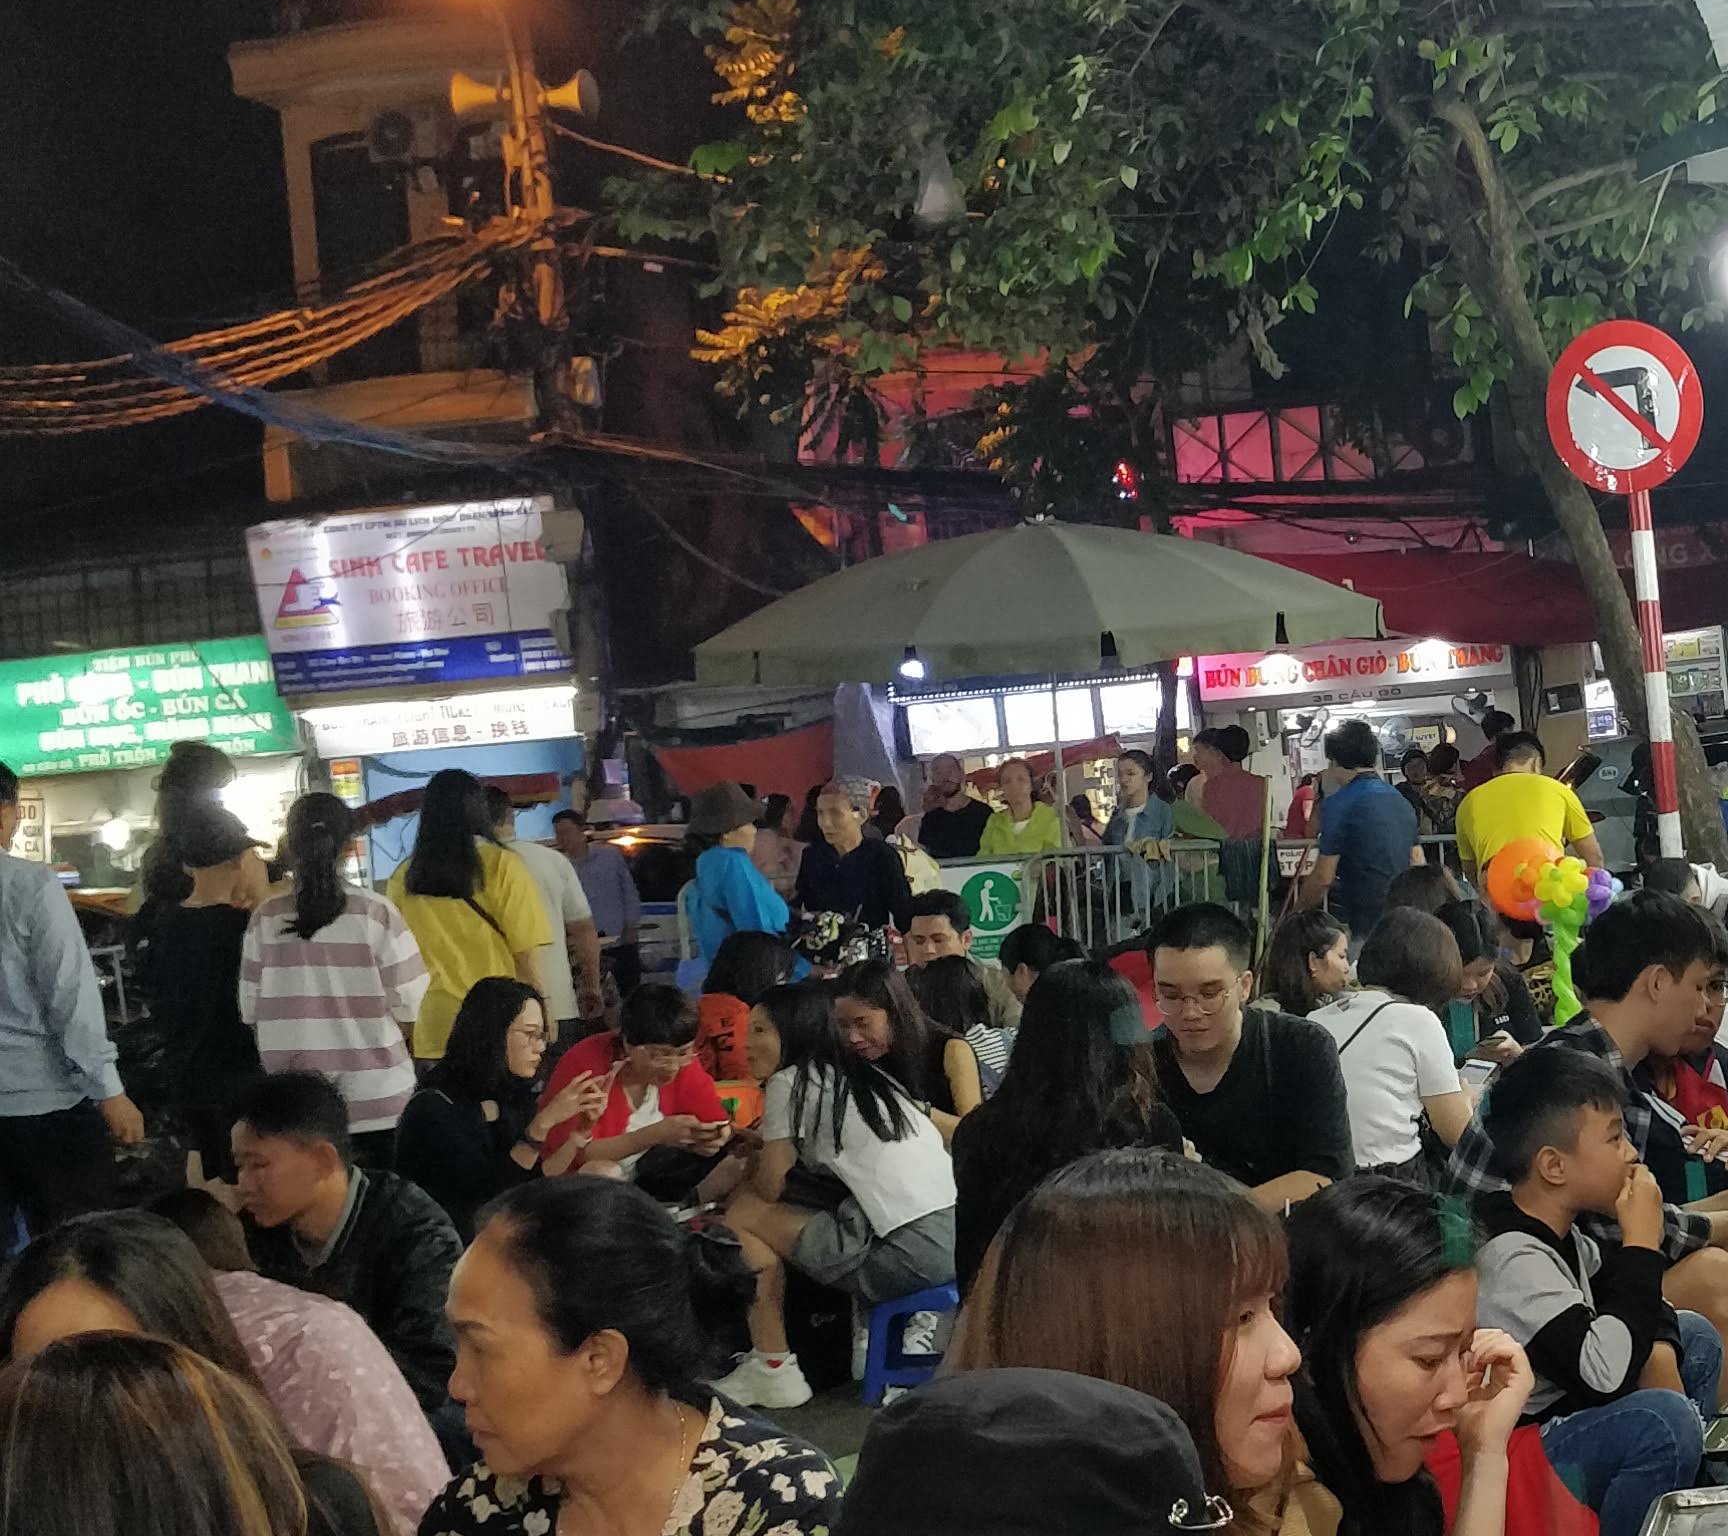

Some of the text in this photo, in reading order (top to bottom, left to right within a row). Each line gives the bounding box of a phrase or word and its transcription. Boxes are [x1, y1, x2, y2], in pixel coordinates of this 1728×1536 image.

[391, 549, 452, 573] CAFE
[369, 582, 446, 604] BOOKING
[1204, 662, 1242, 690] BÚN
[1301, 651, 1352, 682] CHÂN
[1355, 648, 1388, 676] GIÒ
[161, 693, 209, 717] BÚN
